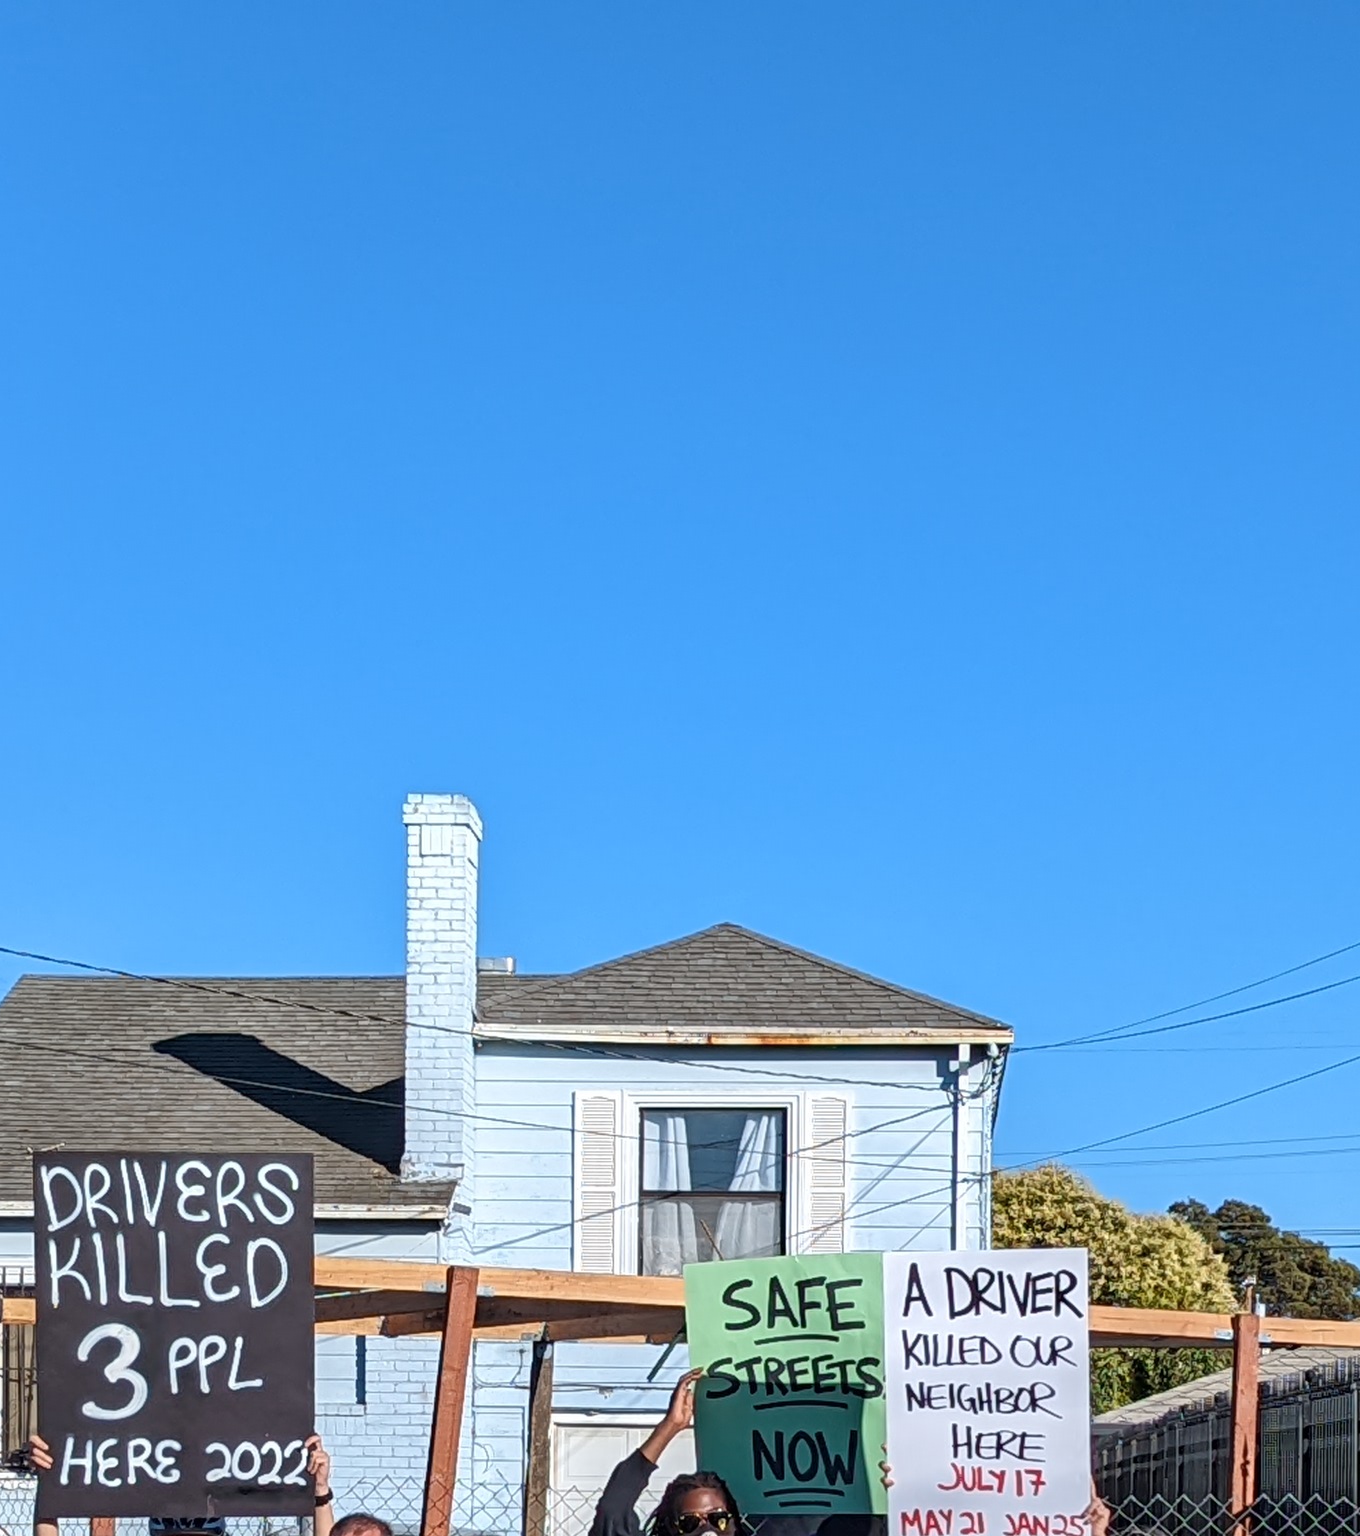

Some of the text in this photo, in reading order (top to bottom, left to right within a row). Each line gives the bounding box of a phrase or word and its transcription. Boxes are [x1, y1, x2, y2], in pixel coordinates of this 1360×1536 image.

[40, 1157, 300, 1232] DRIVERS
[48, 1230, 289, 1309] KILLED
[902, 1263, 1084, 1319] A DRIVER
[721, 1275, 866, 1332] SAFE
[77, 1322, 263, 1421] 3 PPL
[901, 1329, 1078, 1370] KILLED OUR
[706, 1354, 883, 1399] STREETS
[905, 1381, 1063, 1420] NEIGHBOR
[59, 1436, 308, 1488] HERE 2022
[752, 1429, 859, 1487] NOW
[951, 1423, 1047, 1463] HERE
[937, 1463, 1047, 1497] JULY 17
[900, 1509, 954, 1536] MAY
[958, 1511, 986, 1535] 21
